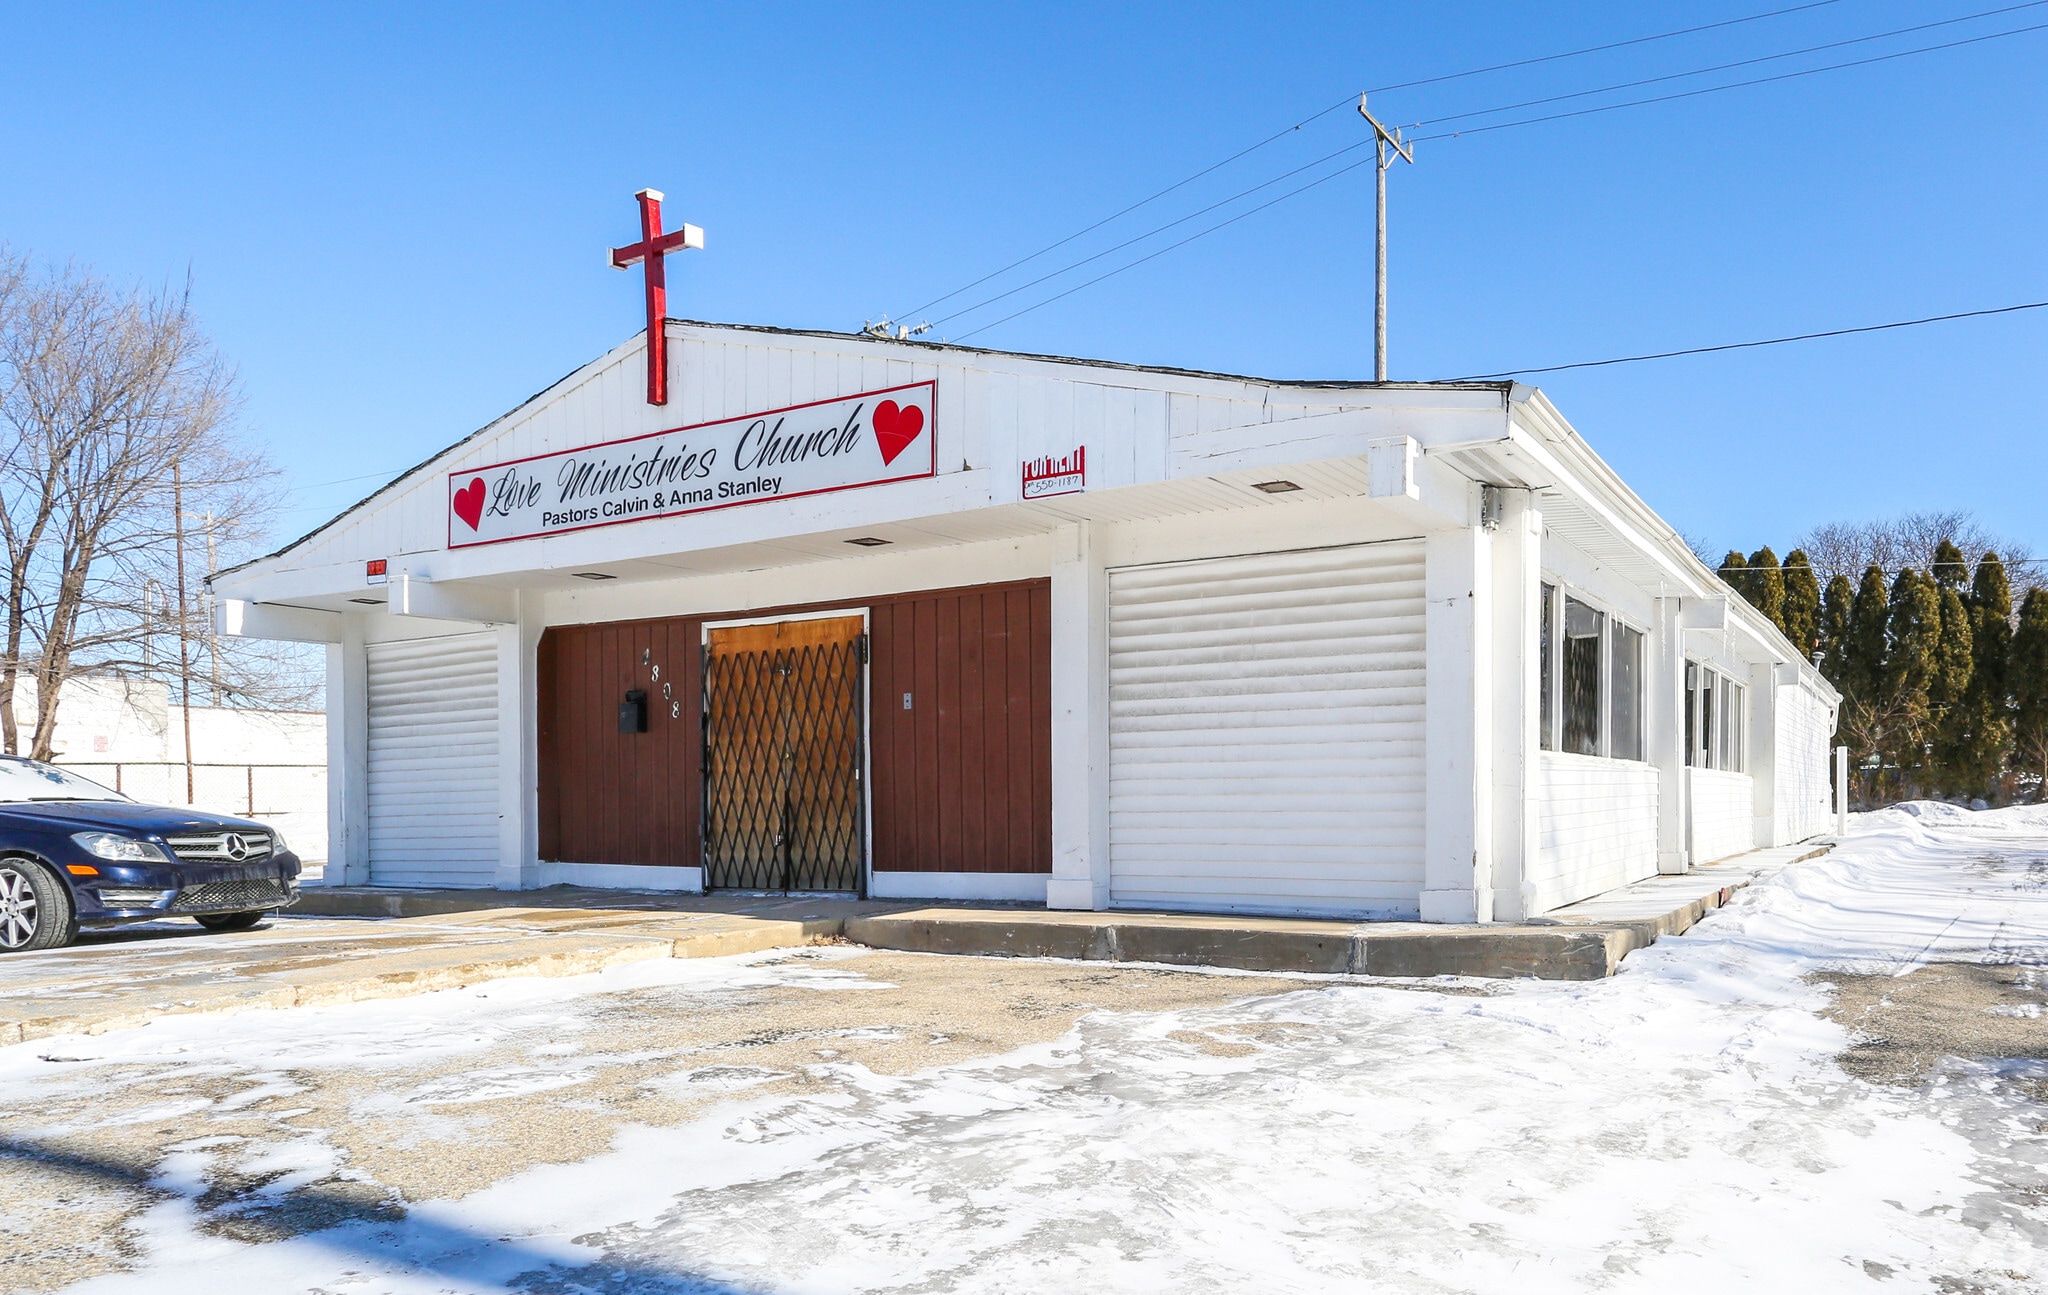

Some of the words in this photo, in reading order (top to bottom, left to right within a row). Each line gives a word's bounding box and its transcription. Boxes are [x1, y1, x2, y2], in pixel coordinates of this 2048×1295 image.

[486, 467, 542, 517] Love
[557, 443, 718, 504] Ministries
[733, 402, 864, 472] Church
[542, 507, 599, 527] Pastors
[602, 496, 649, 517] Calvin
[652, 492, 666, 509] &
[669, 487, 714, 506] Anna
[717, 476, 782, 499] Stanley
